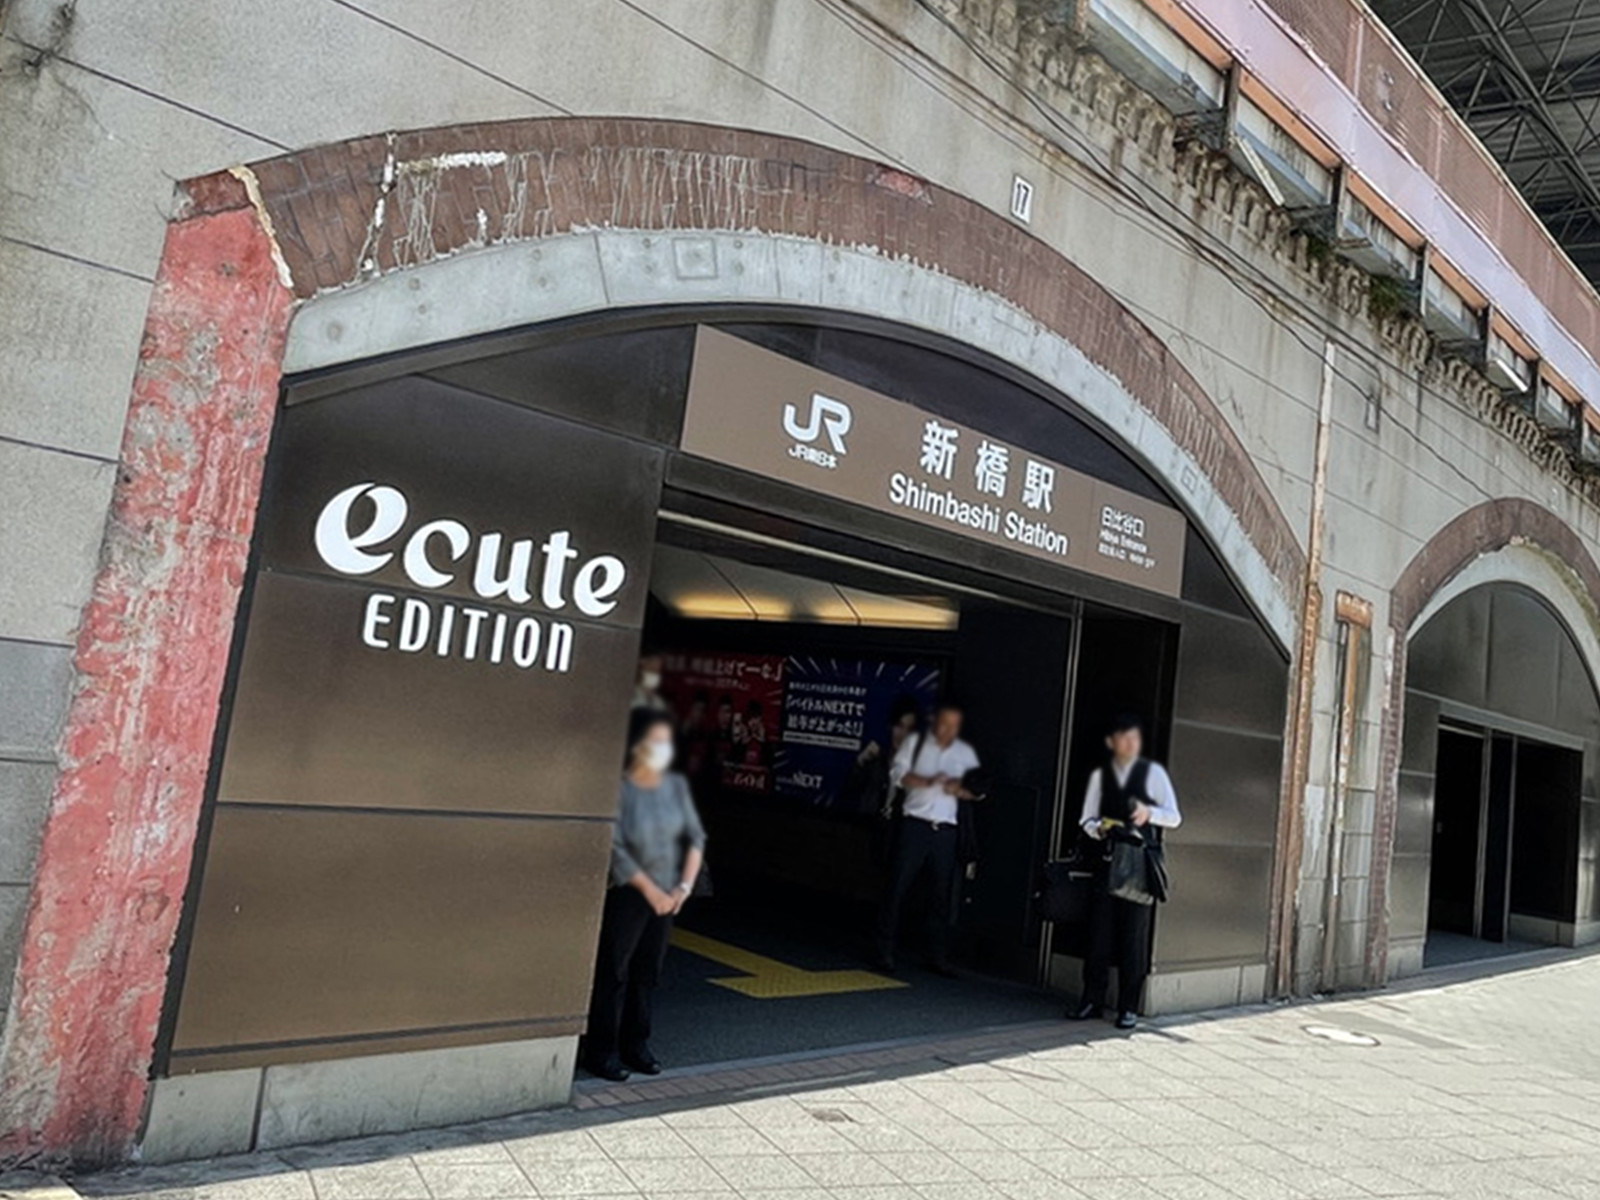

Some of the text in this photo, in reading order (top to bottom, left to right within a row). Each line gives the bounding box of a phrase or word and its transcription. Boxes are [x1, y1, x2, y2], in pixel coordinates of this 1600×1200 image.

[1015, 182, 1029, 215] 17
[783, 394, 851, 454] JR
[920, 420, 1056, 514] 新橋駅
[315, 482, 626, 617] ecute
[889, 472, 1068, 556] Shimbashi Station
[1102, 506, 1145, 538] 日比谷口
[363, 594, 573, 672] EDITION
